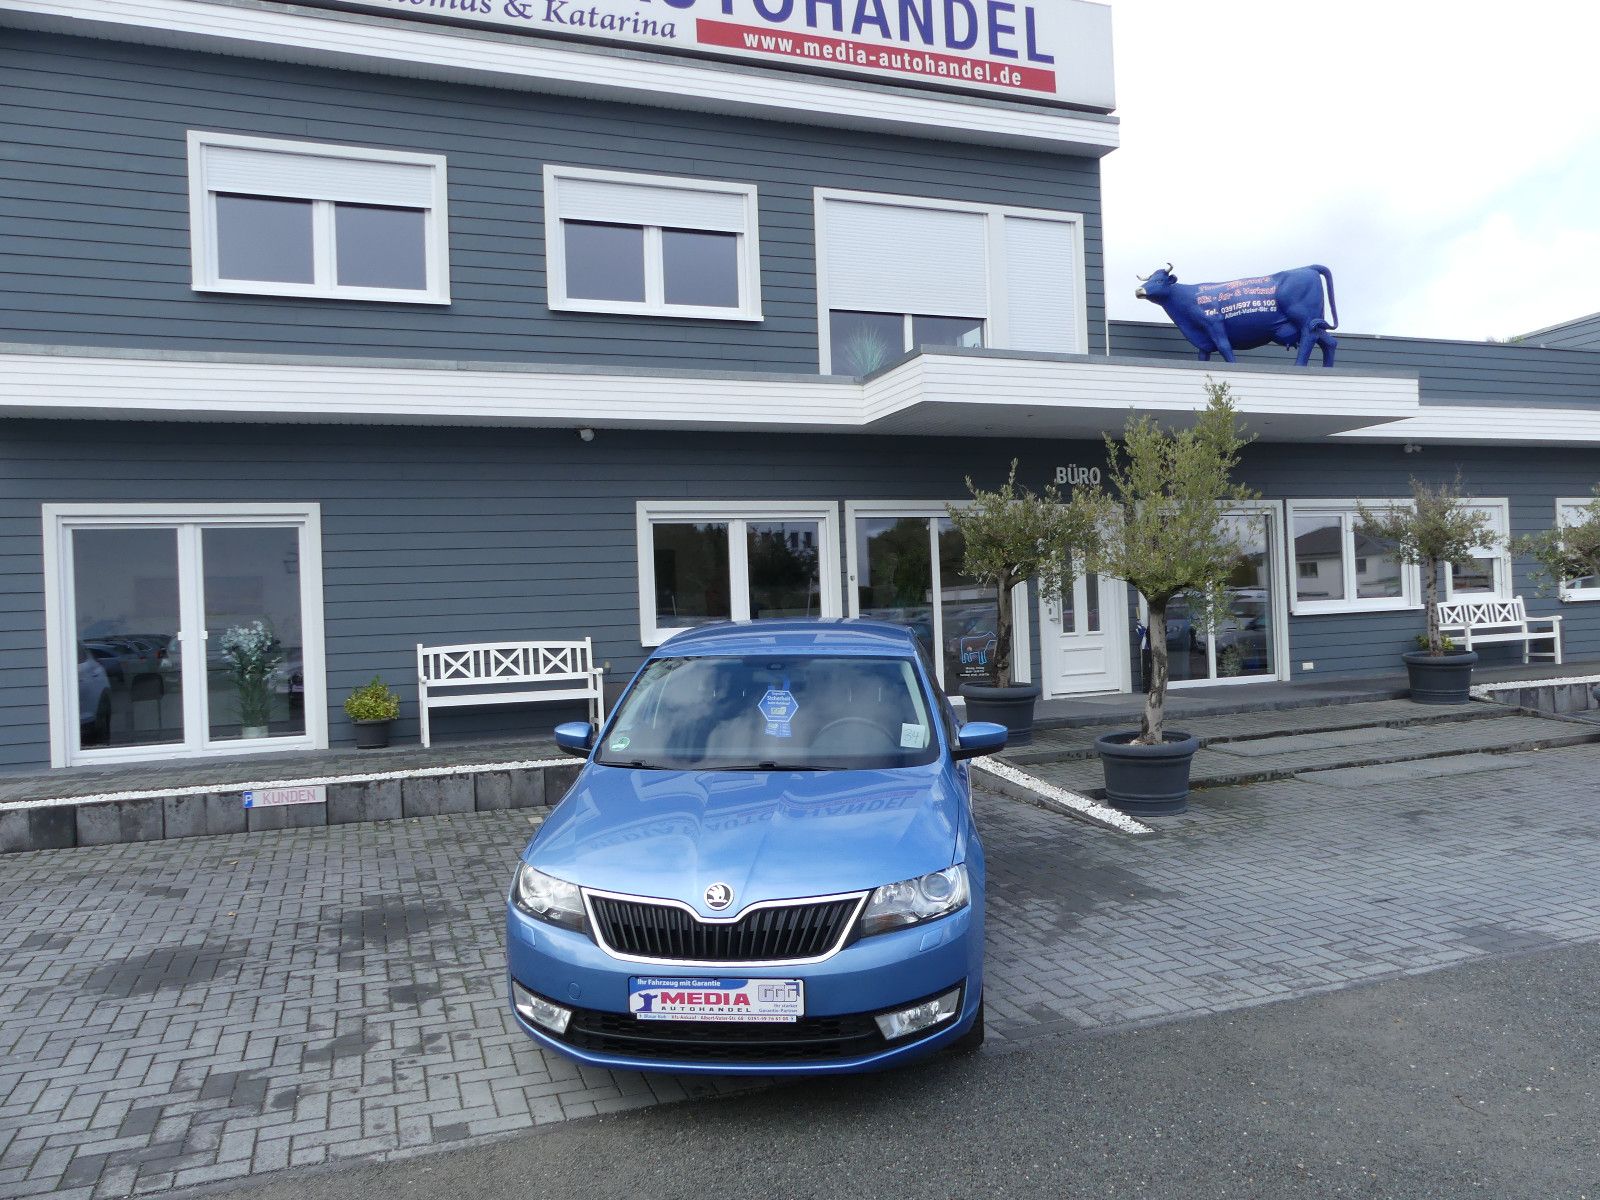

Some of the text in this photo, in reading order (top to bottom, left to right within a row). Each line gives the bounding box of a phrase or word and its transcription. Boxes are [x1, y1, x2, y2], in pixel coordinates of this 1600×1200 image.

[503, 0, 533, 20] &
[541, 0, 677, 39] Katarina
[743, 33, 1022, 86] www.media-autohandel.de
[1205, 308, 1219, 316] Tel.
[1221, 300, 1251, 314] 0391/597
[1056, 463, 1101, 485] BÜRO
[263, 789, 316, 805] KUNDEN
[648, 979, 679, 987] Fahrzeug
[660, 991, 751, 1006] MEDIA
